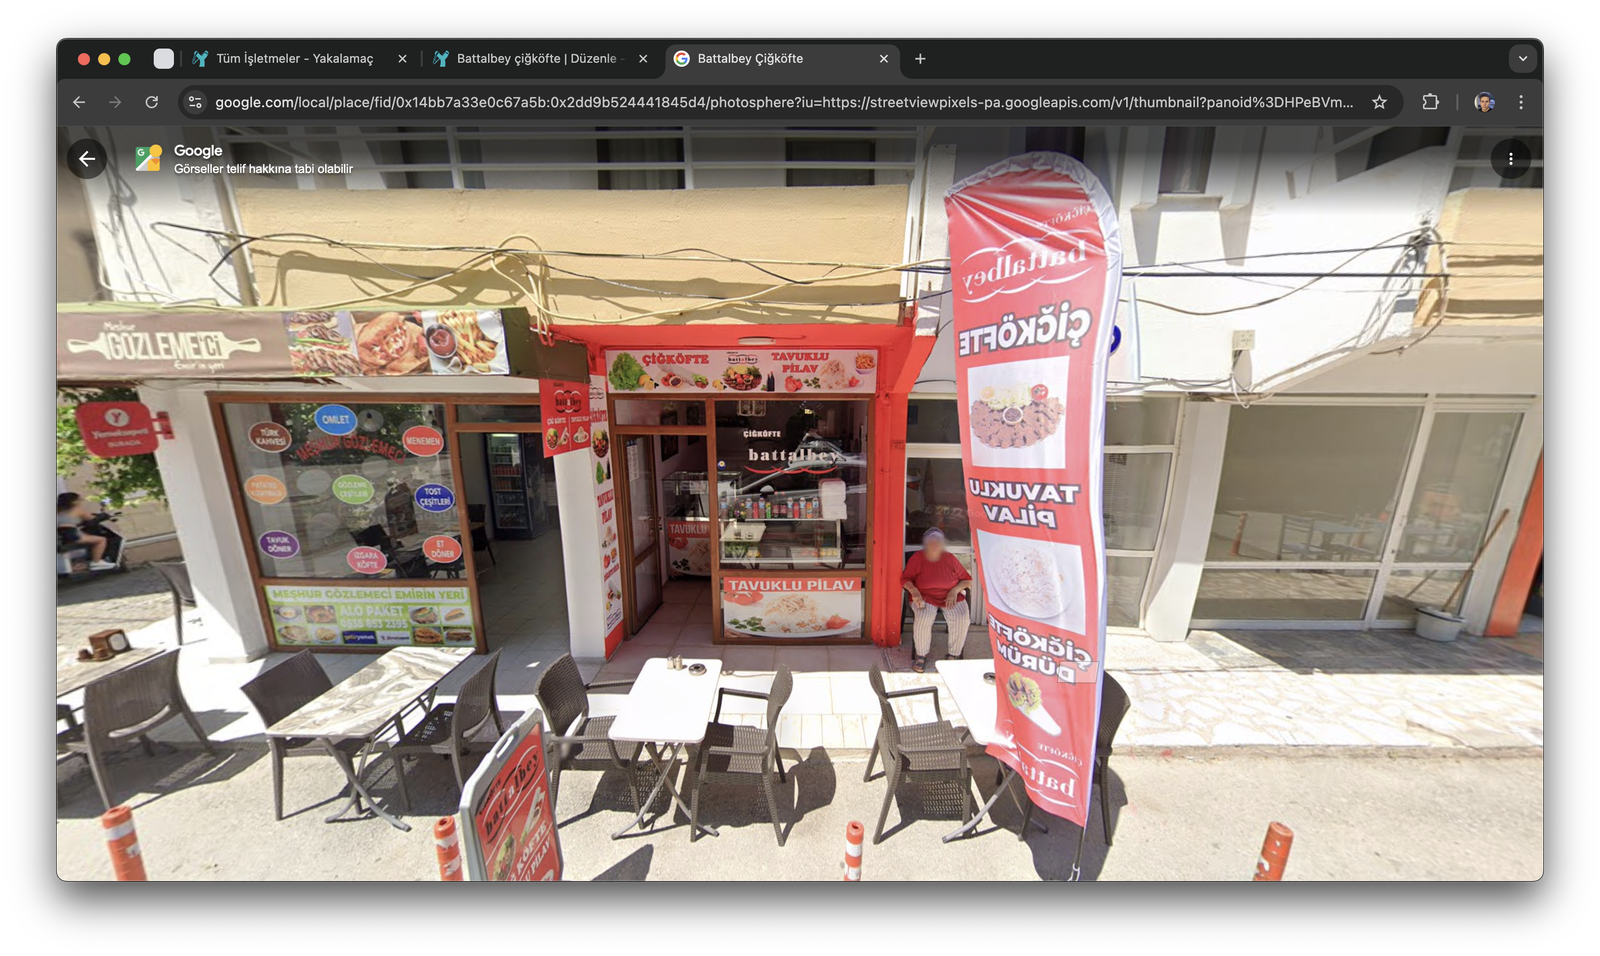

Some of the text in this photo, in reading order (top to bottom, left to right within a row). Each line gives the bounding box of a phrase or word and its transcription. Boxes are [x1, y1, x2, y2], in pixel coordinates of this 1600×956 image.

[217, 52, 240, 65] Tüm
[243, 51, 301, 68] İşletmeler
[312, 52, 374, 68] Yakalamaç
[457, 52, 510, 68] Battalbey
[514, 51, 561, 68] çiğköfte
[571, 52, 617, 65] Düzenle
[698, 52, 804, 68] Battalbey Çiğköfte
[642, 352, 709, 366] ÇİĞKÖFTE
[771, 352, 829, 361] TAVUKLU
[782, 362, 819, 373] PİLAV
[322, 414, 350, 425] OMLET
[743, 429, 781, 439] ÇİĞKÖFTE
[406, 436, 441, 446] MENEMEN
[748, 448, 840, 465] battalbey
[424, 487, 441, 496] TOST
[670, 523, 707, 534] TAVUKLU
[729, 578, 854, 591] TAVUKLU PİLAV
[273, 587, 465, 602] MEŞHUR GÖZLEMECİ EMİRİN YERİ
[366, 605, 403, 617] PAKET
[485, 751, 539, 836] battalbey
[516, 819, 547, 873] KÖFTE
[530, 836, 551, 876] PİLAV
